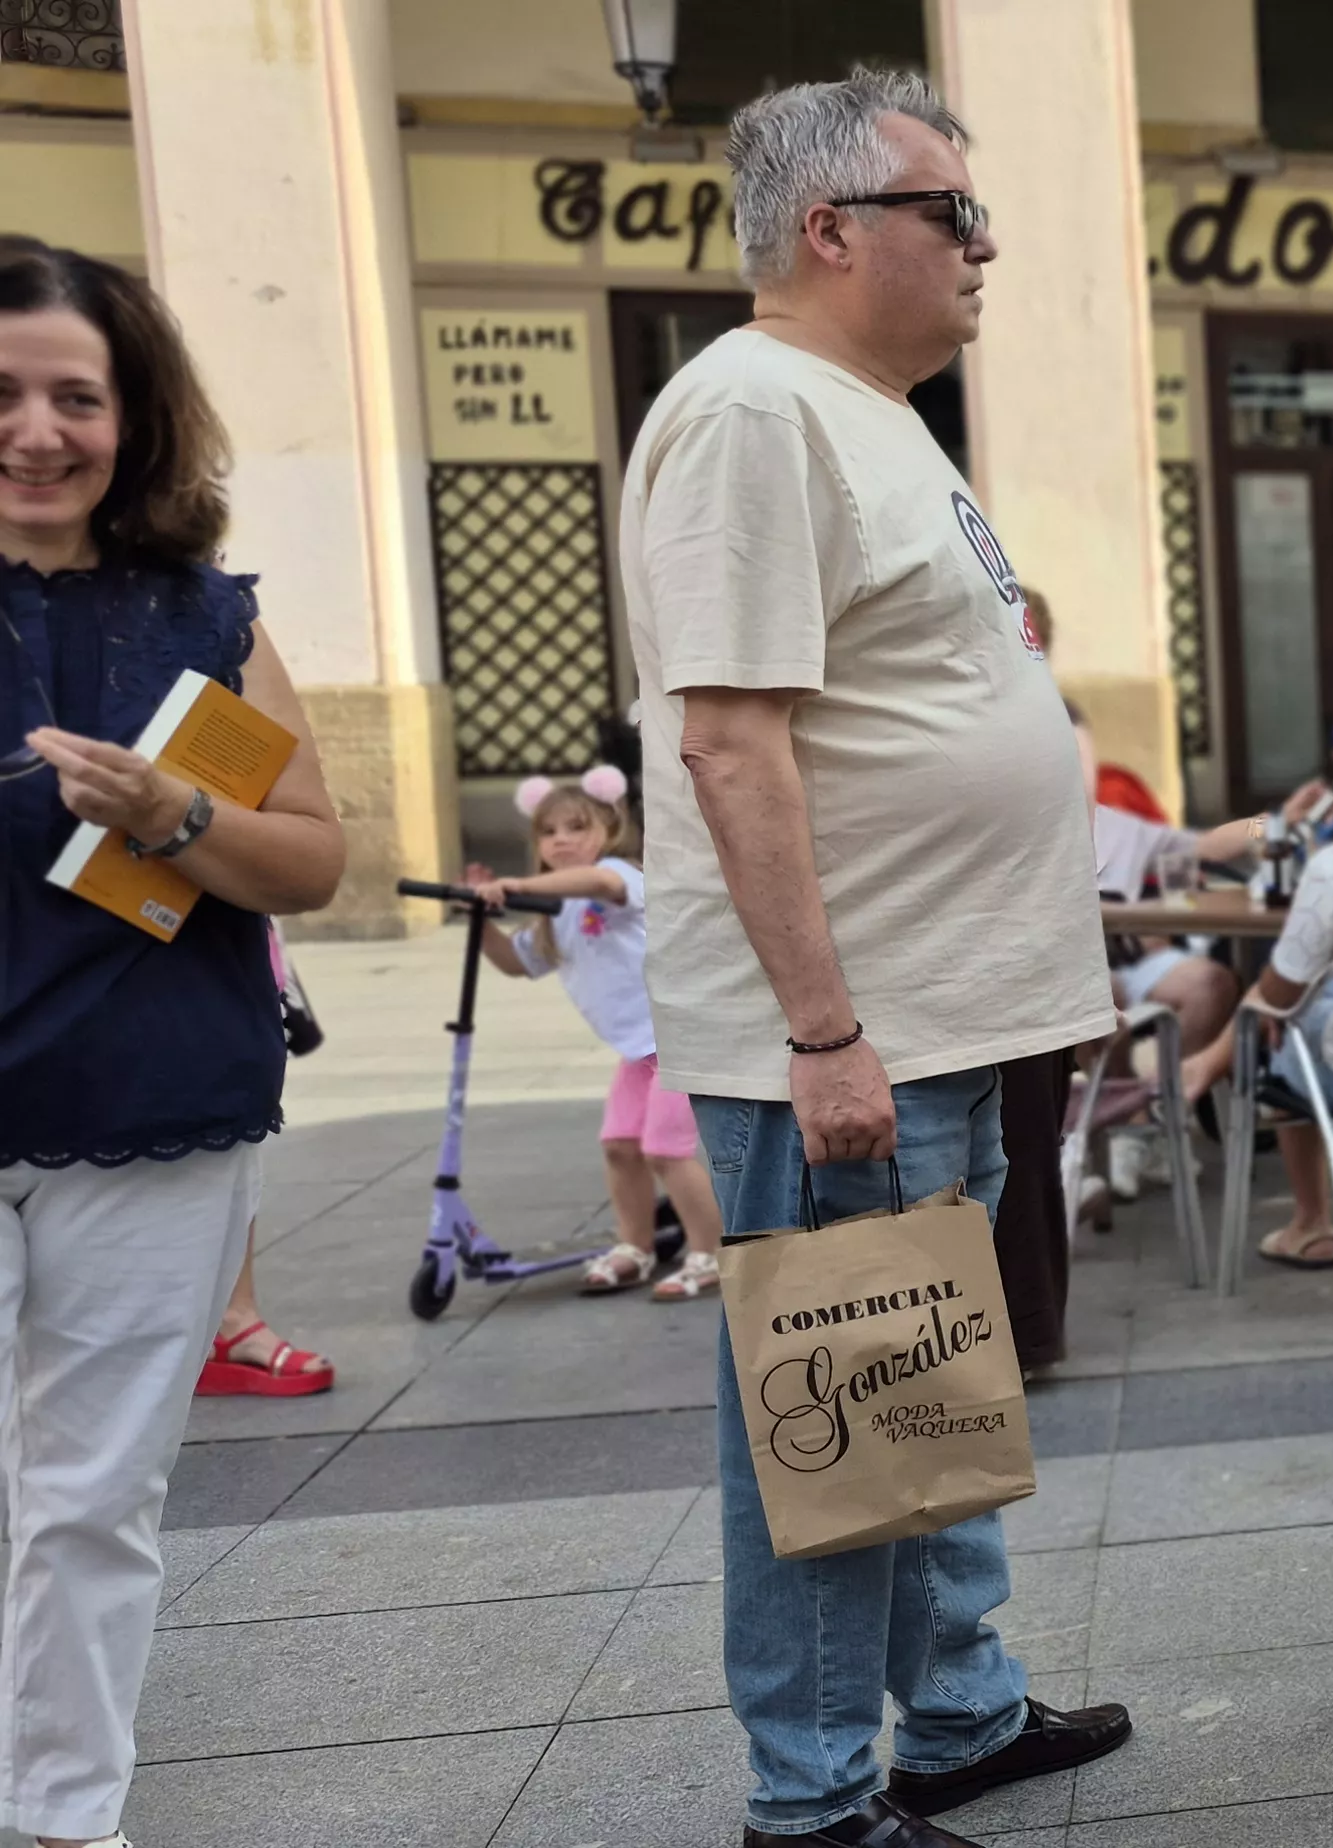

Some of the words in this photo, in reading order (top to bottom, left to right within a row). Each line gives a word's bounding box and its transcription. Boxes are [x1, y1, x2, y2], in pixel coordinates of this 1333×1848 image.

[535, 159, 738, 272] Caf
[438, 318, 575, 351] LLÁMAME
[453, 363, 524, 386] PERO
[511, 393, 552, 425] LL
[771, 1280, 963, 1335] COMERCIAL
[760, 1304, 992, 1472] González
[871, 1402, 947, 1431] MODA
[886, 1412, 1008, 1443] VAQUERA
